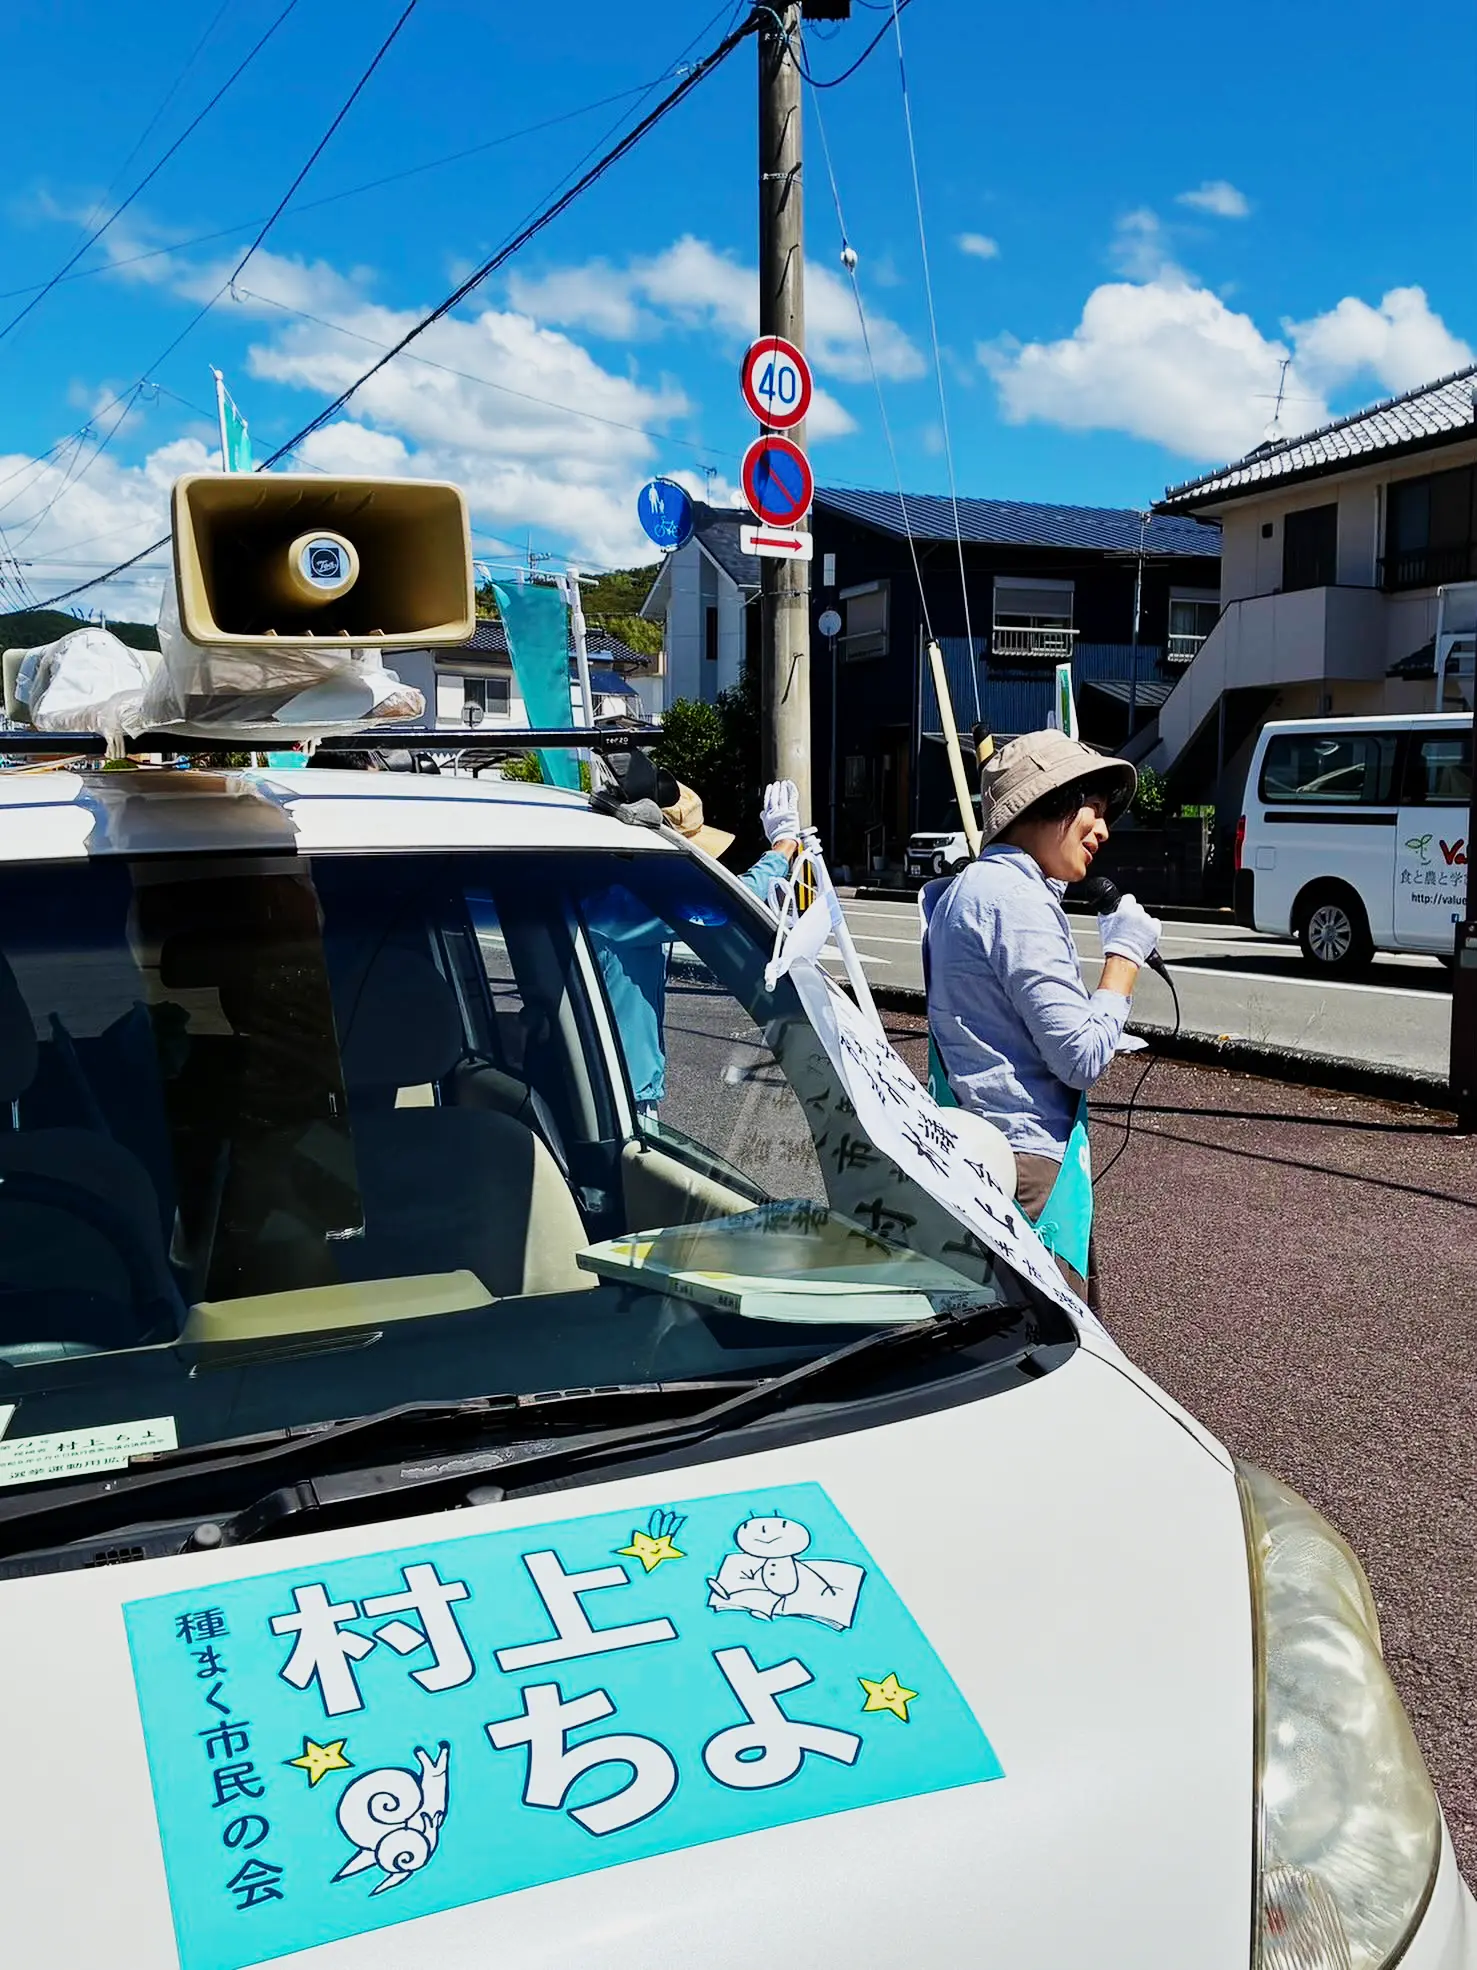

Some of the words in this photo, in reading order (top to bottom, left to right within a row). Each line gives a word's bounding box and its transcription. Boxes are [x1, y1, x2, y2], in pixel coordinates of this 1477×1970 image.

[759, 363, 796, 404] 40
[268, 1549, 680, 1718] 村上
[175, 1607, 285, 1910] 種まく市民の会
[484, 1644, 864, 1838] ちよ
